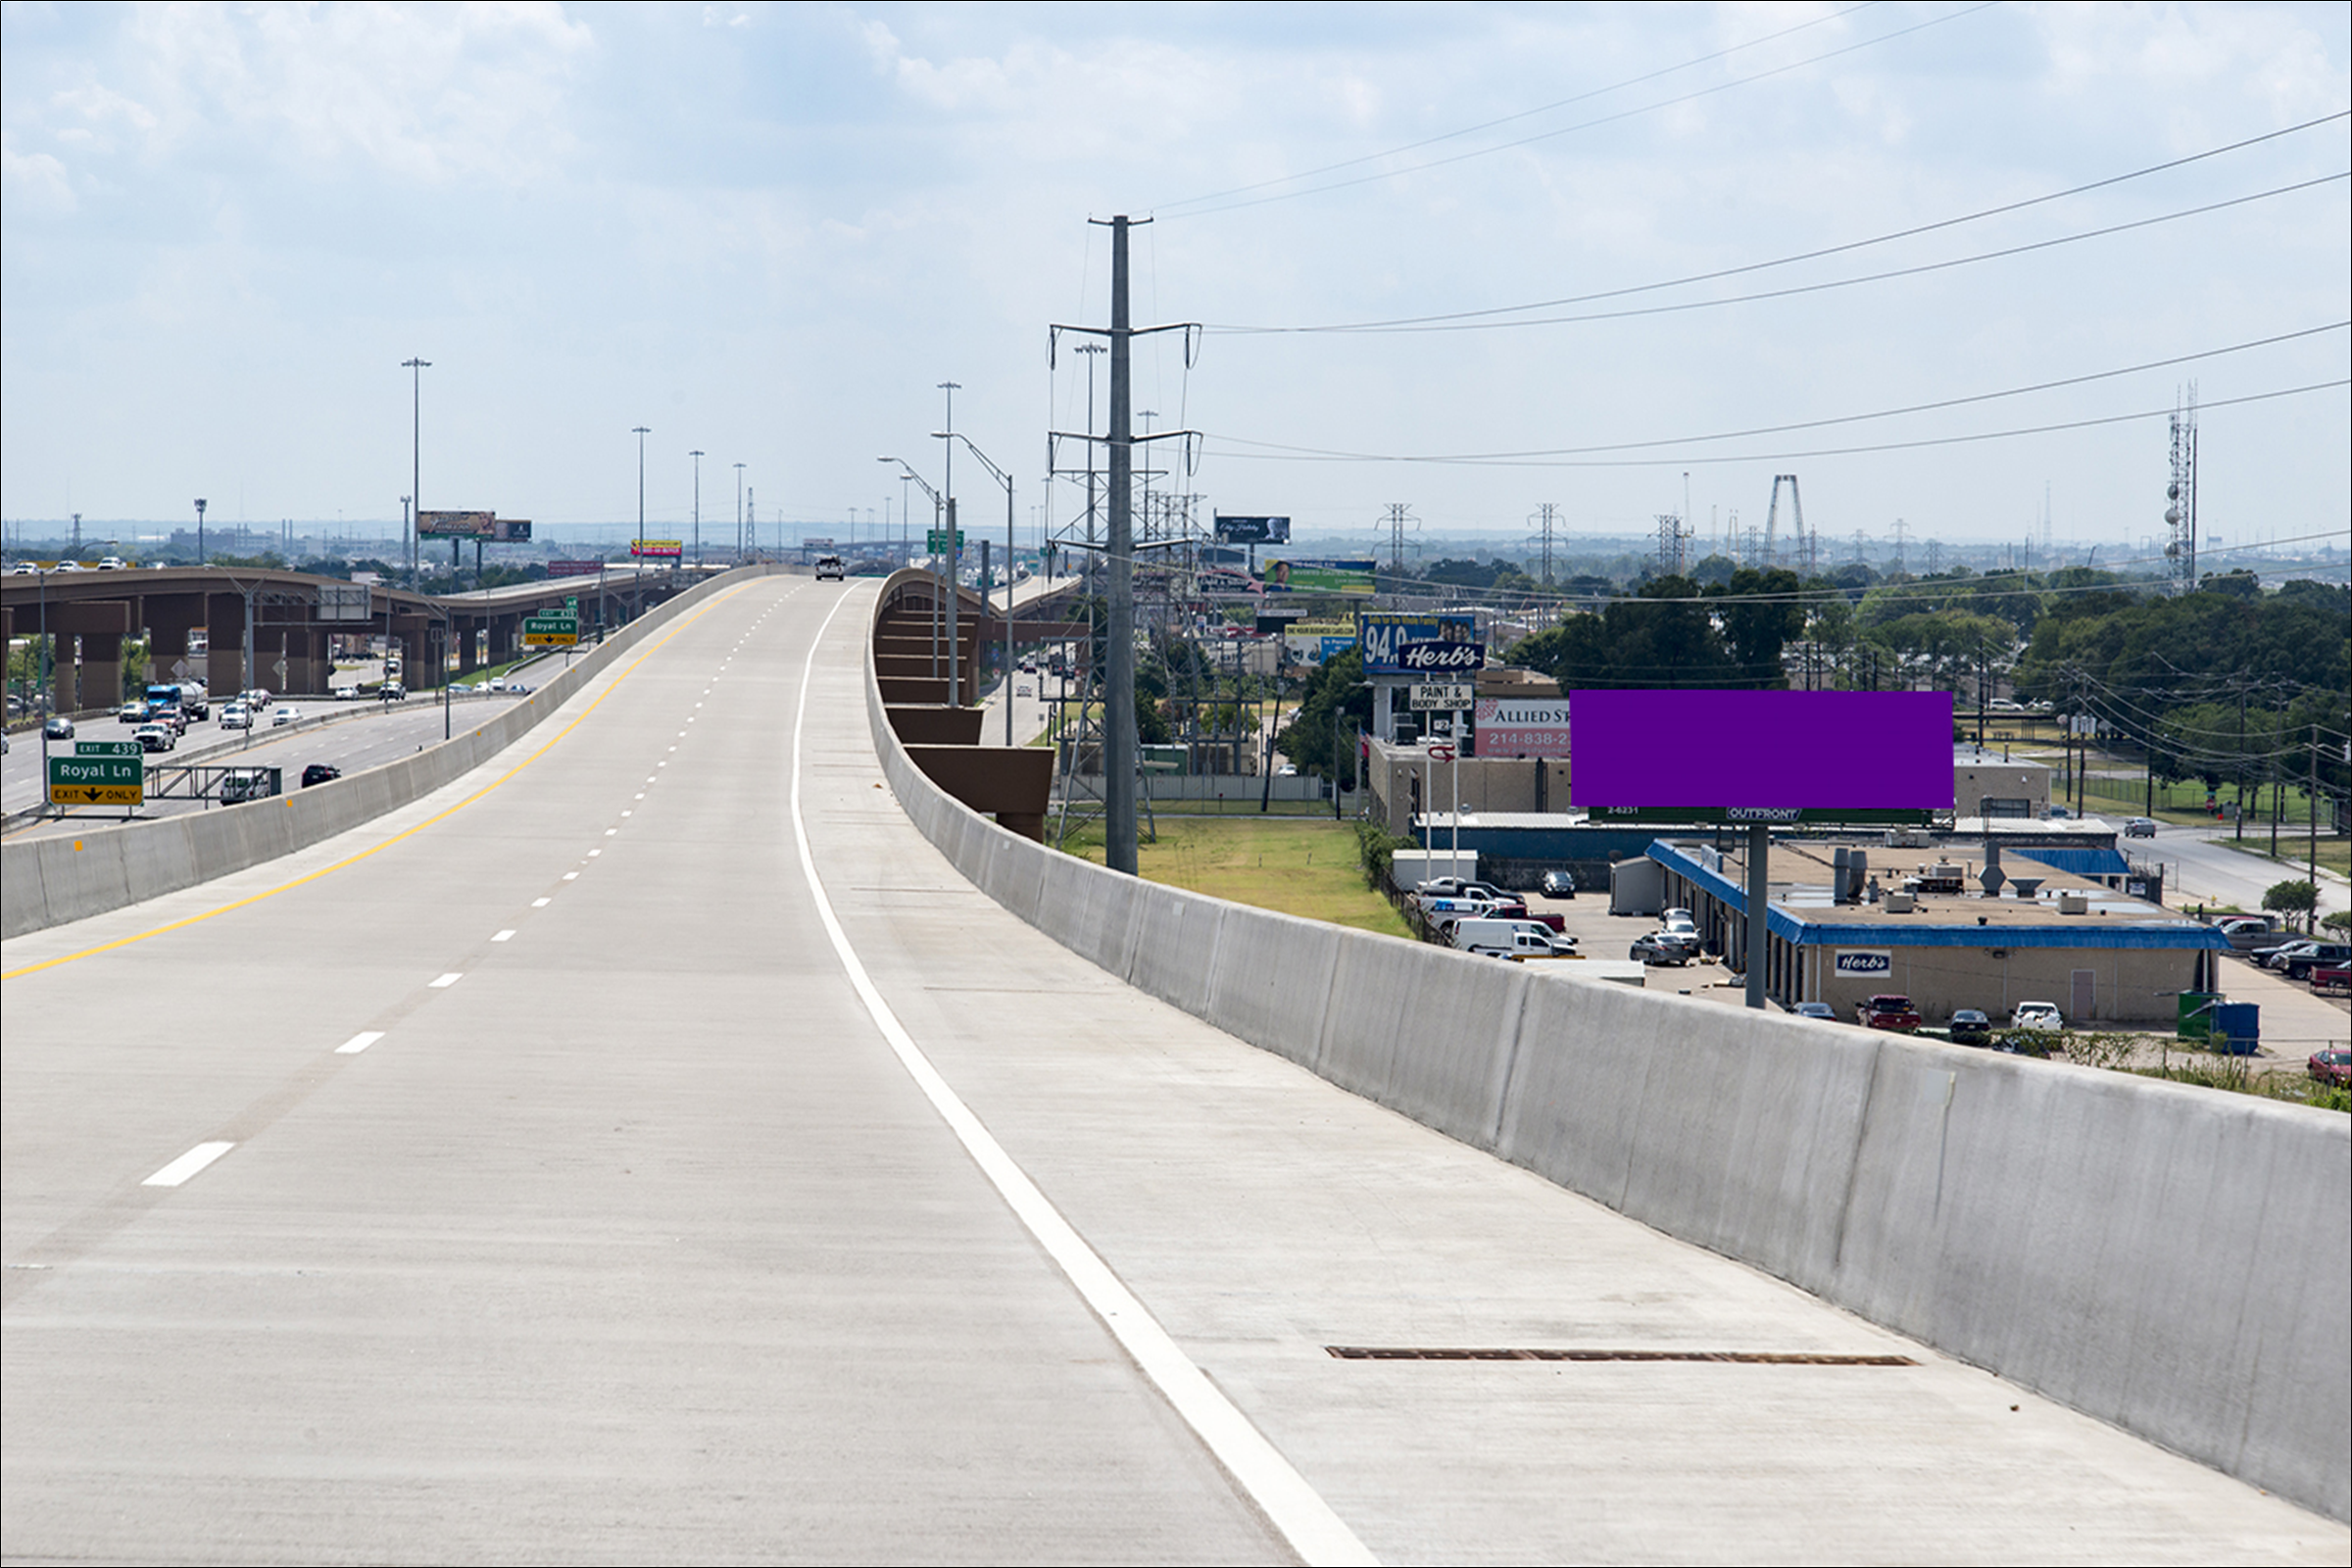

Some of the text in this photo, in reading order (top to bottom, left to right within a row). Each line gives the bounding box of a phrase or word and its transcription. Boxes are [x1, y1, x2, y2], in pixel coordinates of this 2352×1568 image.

[530, 621, 572, 632] Royal Ln
[1405, 645, 1481, 668] Herb's
[1419, 686, 1462, 698] PAINT &
[1411, 699, 1471, 709] BODY SHOP
[1494, 709, 1571, 724] ALLIED ST
[1489, 731, 1571, 746] 214-838-2
[78, 744, 138, 756] EXIT 439
[60, 763, 132, 780] Royal Ln
[54, 789, 138, 800] EXIT ONLY
[1729, 808, 1798, 821] OUTFRONT
[1841, 955, 1886, 969] Herb's
